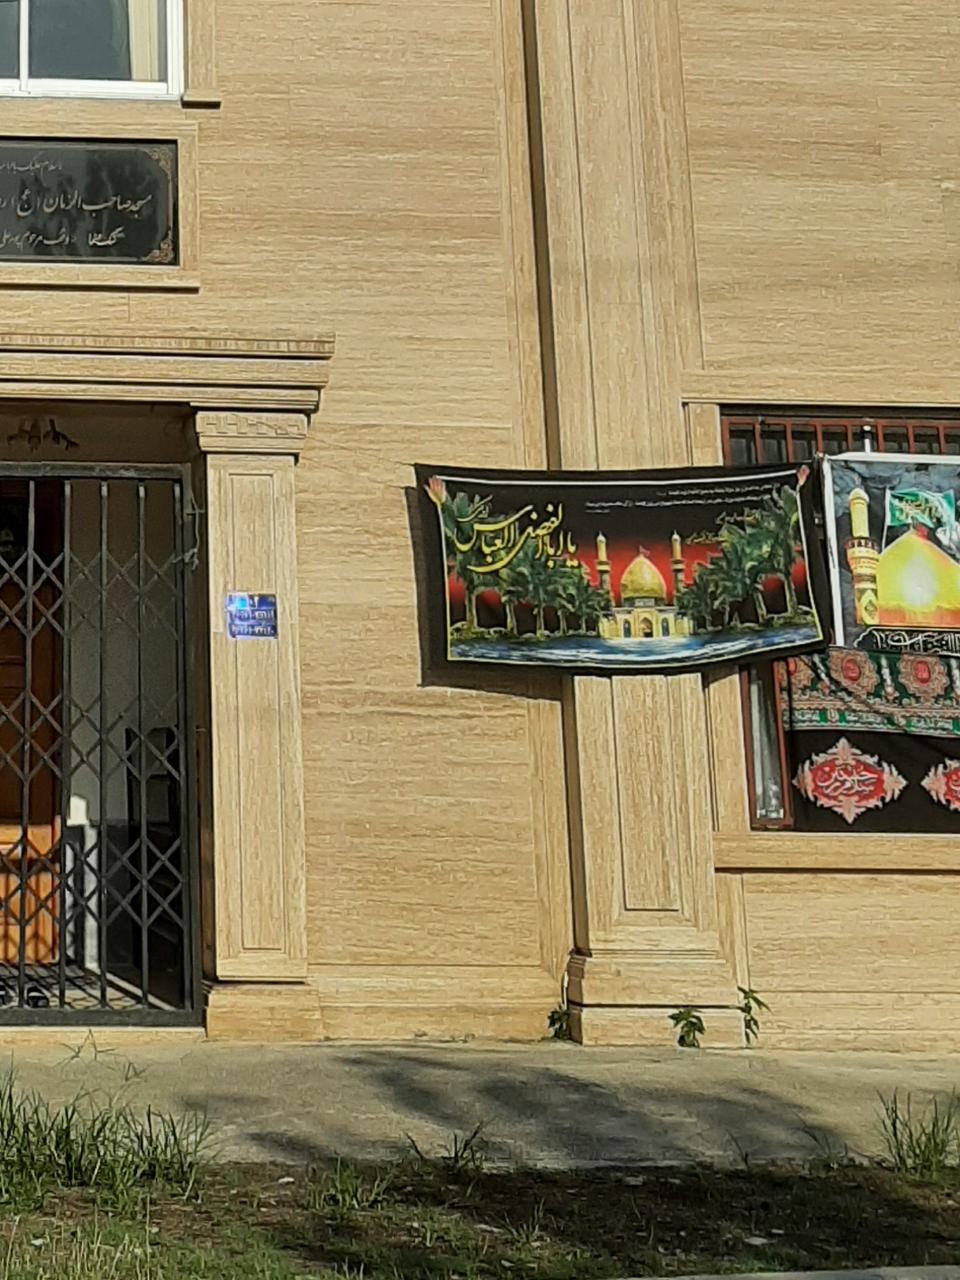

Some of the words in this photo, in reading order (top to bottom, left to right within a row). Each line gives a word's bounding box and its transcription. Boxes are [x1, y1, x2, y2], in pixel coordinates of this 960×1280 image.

[43, 189, 81, 213] الزمان
[82, 194, 131, 217] صاحب
[129, 194, 153, 218] مسجد
